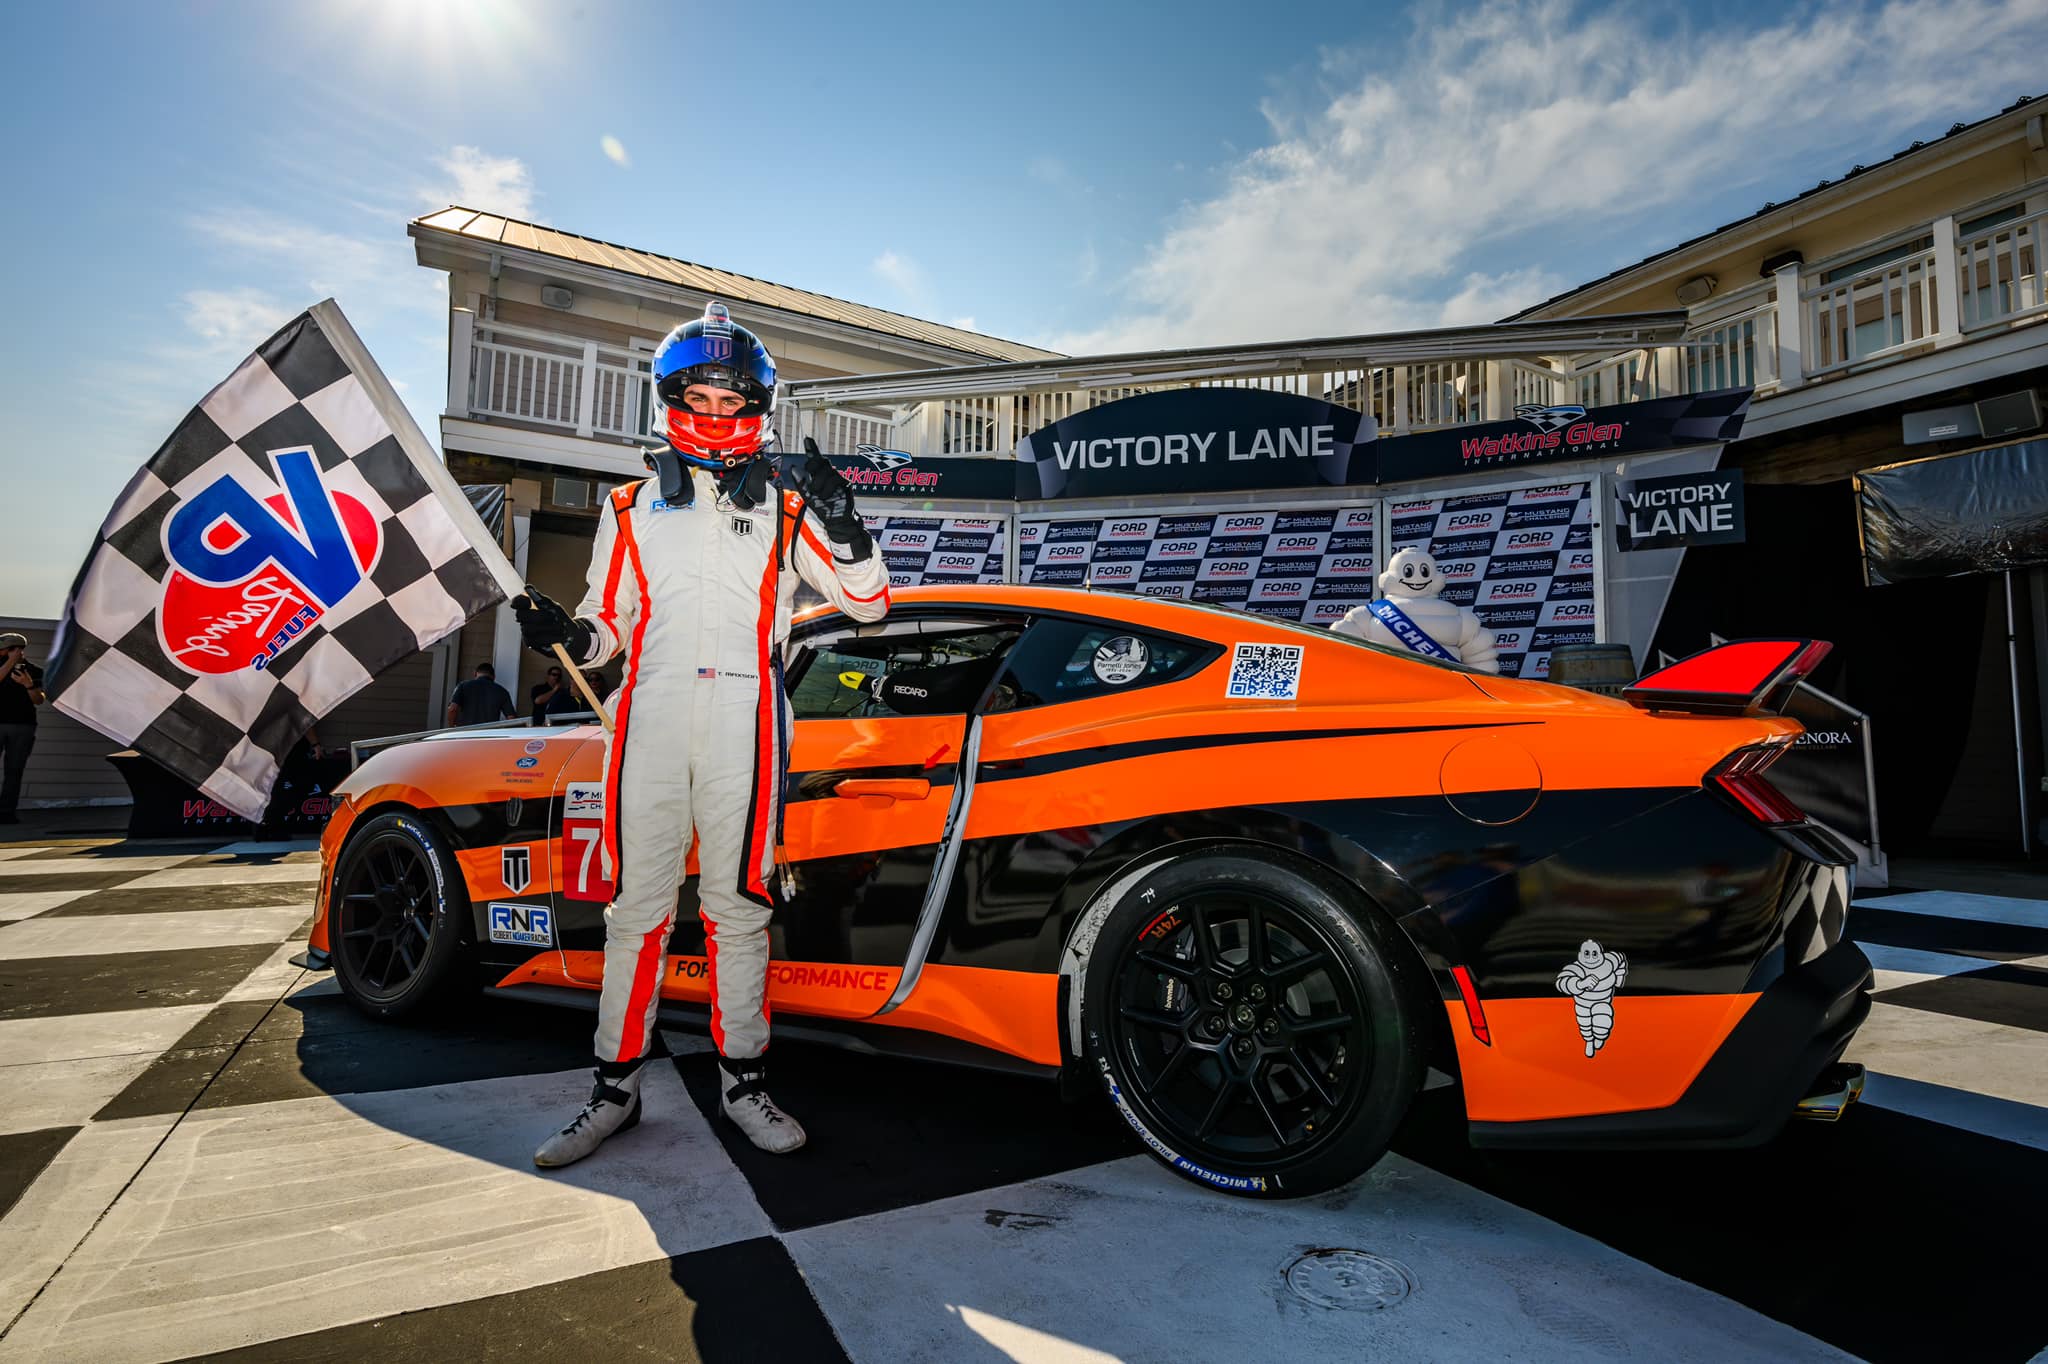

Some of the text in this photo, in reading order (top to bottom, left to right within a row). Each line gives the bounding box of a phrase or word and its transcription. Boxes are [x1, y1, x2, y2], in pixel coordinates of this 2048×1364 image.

[1462, 422, 1622, 459] Watkins Glen
[1053, 425, 1334, 470] VICTORY LANE
[1464, 441, 1619, 466] INTERNATIONAL
[832, 466, 938, 486] tkins Glen
[853, 485, 936, 493] RNATIONAL
[1523, 490, 1570, 500] PERFORMANCE
[1628, 482, 1731, 508] VICTORY
[1348, 512, 1373, 522] FO
[1524, 508, 1570, 516] MUSTANG
[1226, 517, 1265, 527] FORD
[1449, 513, 1492, 526] FORD
[1630, 504, 1733, 538] LANE
[1111, 522, 1148, 532] FORD
[1392, 522, 1432, 531] MUSTANG
[1392, 527, 1432, 536] CHALLENGE
[1448, 522, 1490, 532] PERFORMANCE
[891, 534, 927, 543] FORD
[1278, 538, 1318, 547] FORD
[1448, 539, 1490, 547] MUSTANG
[1508, 532, 1554, 544] FORD
[1160, 542, 1198, 552] FORD
[1448, 544, 1490, 552] CHALLENGE
[1506, 541, 1552, 550] PERFORMANCE
[1050, 546, 1085, 556] FORD
[938, 556, 976, 566] FORD
[1332, 558, 1373, 568] FORD
[1508, 559, 1553, 567] MUSTANG
[1571, 554, 1593, 564] FO
[1096, 566, 1132, 574] FORD
[1210, 562, 1250, 571] FORD
[1508, 564, 1553, 572] CHALLENGE
[1146, 586, 1181, 595] FORD
[1262, 582, 1302, 592] FORD
[1491, 583, 1538, 594] FORD
[1440, 589, 1474, 597] USTANG
[1489, 592, 1536, 600] PERFORMANCE
[1491, 610, 1536, 618] MUSTANG
[1492, 615, 1536, 623] CHALLENGE
[1377, 604, 1453, 662] MICHEL
[1554, 632, 1595, 640] MUSTAN
[1495, 634, 1520, 643] RD
[893, 685, 928, 698] RECARO
[1796, 731, 1852, 745] ENORA
[1141, 887, 1156, 904] 74
[492, 907, 549, 934] RNR
[675, 960, 889, 991] FOR FORMANCE
[1164, 978, 1175, 1011] brembo
[1111, 1107, 1147, 1137] SPORT
[1146, 1135, 1173, 1158] PILOT
[1179, 1160, 1248, 1188] MICHELIN
